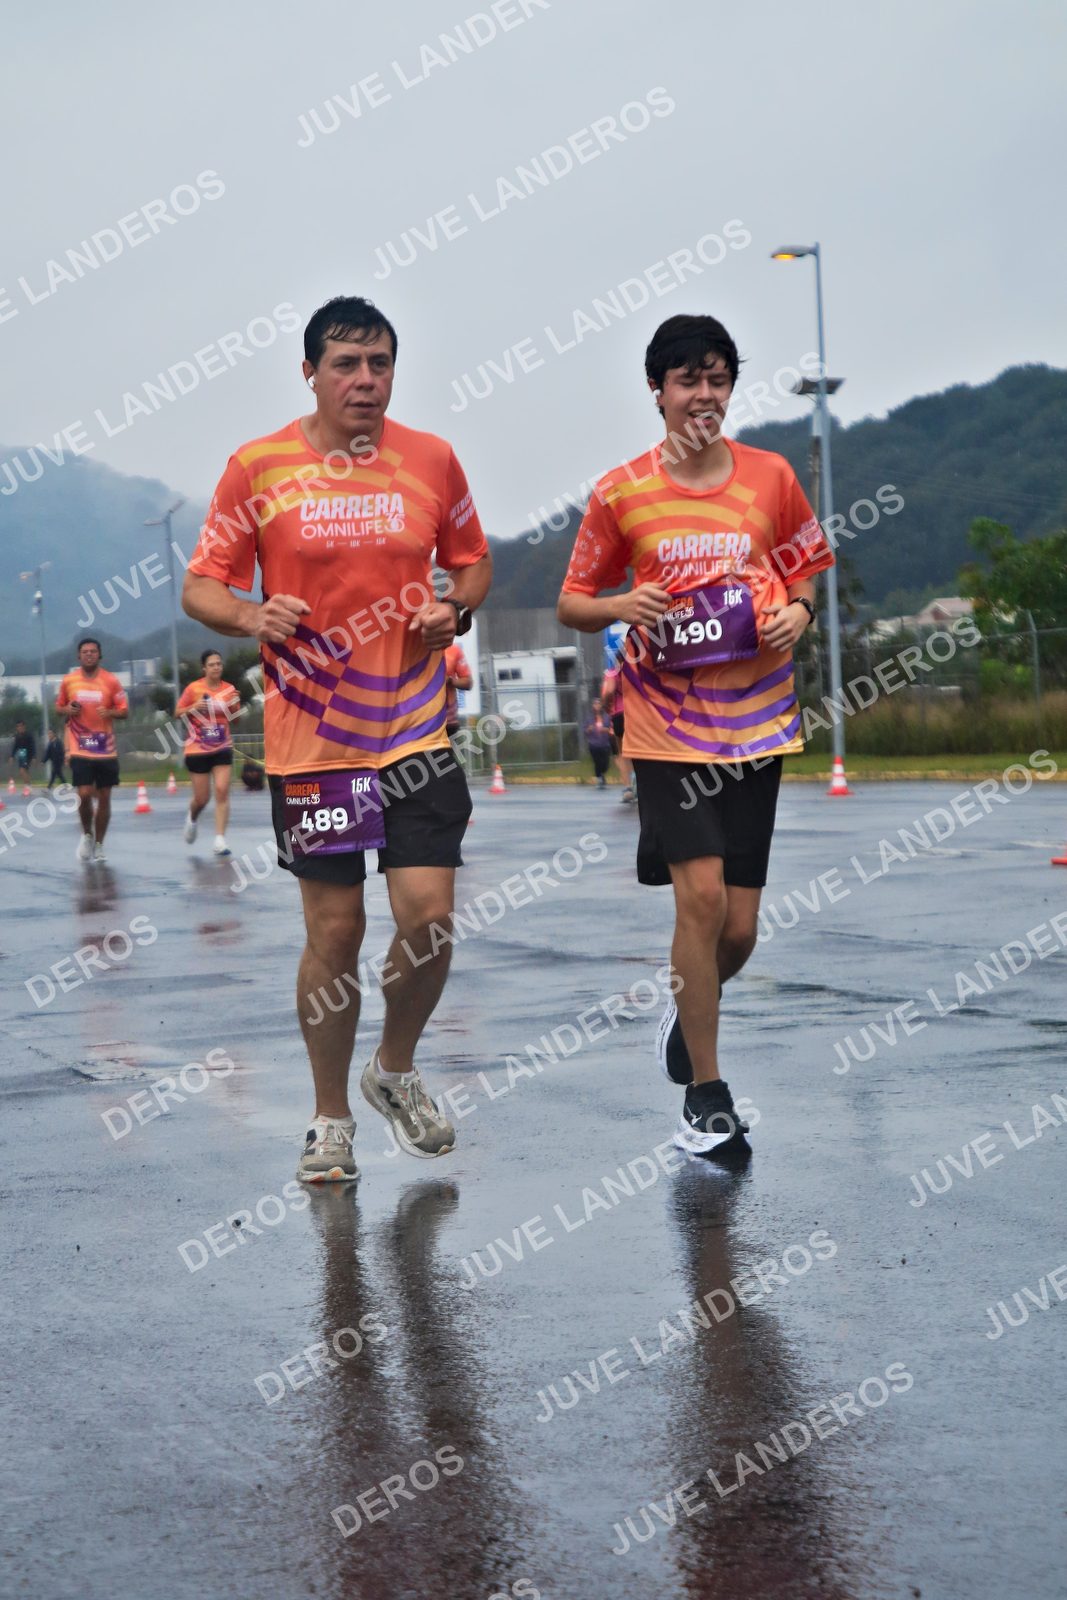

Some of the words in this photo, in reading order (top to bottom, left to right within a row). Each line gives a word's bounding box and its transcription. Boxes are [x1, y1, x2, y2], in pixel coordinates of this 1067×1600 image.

[300, 493, 404, 522] CARRERA
[301, 520, 384, 539] OMNILIFE
[658, 532, 751, 562] CARRERA
[662, 560, 730, 578] OMNILIFE
[674, 618, 722, 646] 490
[302, 807, 348, 832] 489
